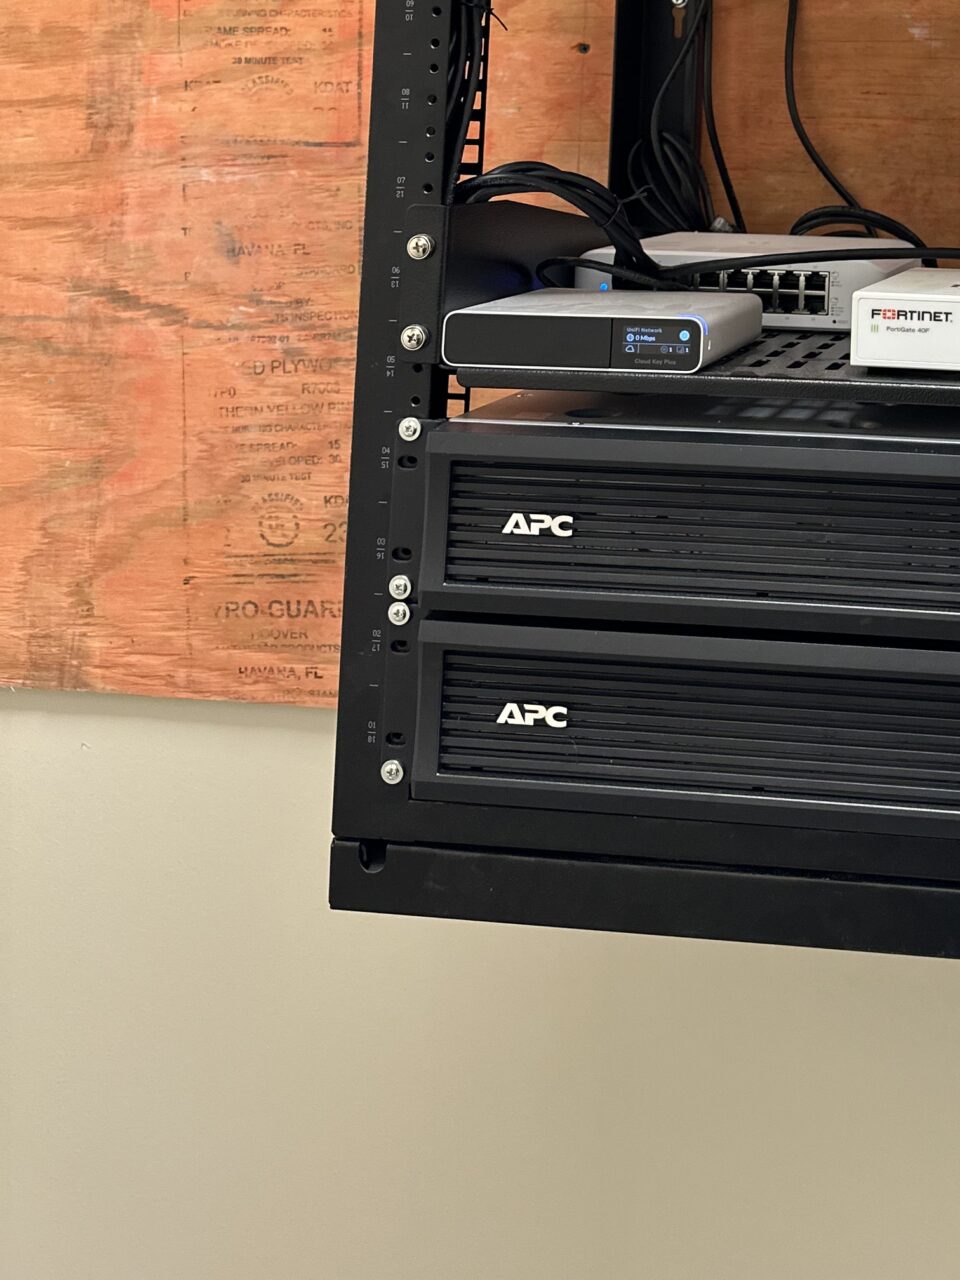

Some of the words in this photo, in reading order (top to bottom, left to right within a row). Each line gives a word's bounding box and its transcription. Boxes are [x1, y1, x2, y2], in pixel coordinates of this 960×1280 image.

[313, 80, 353, 95] KDAT
[871, 308, 953, 323] FORTINET
[886, 325, 916, 333] FortiGate
[327, 440, 341, 450] 15
[501, 512, 574, 537] APC
[304, 666, 324, 680] FL
[496, 702, 568, 728] APC
